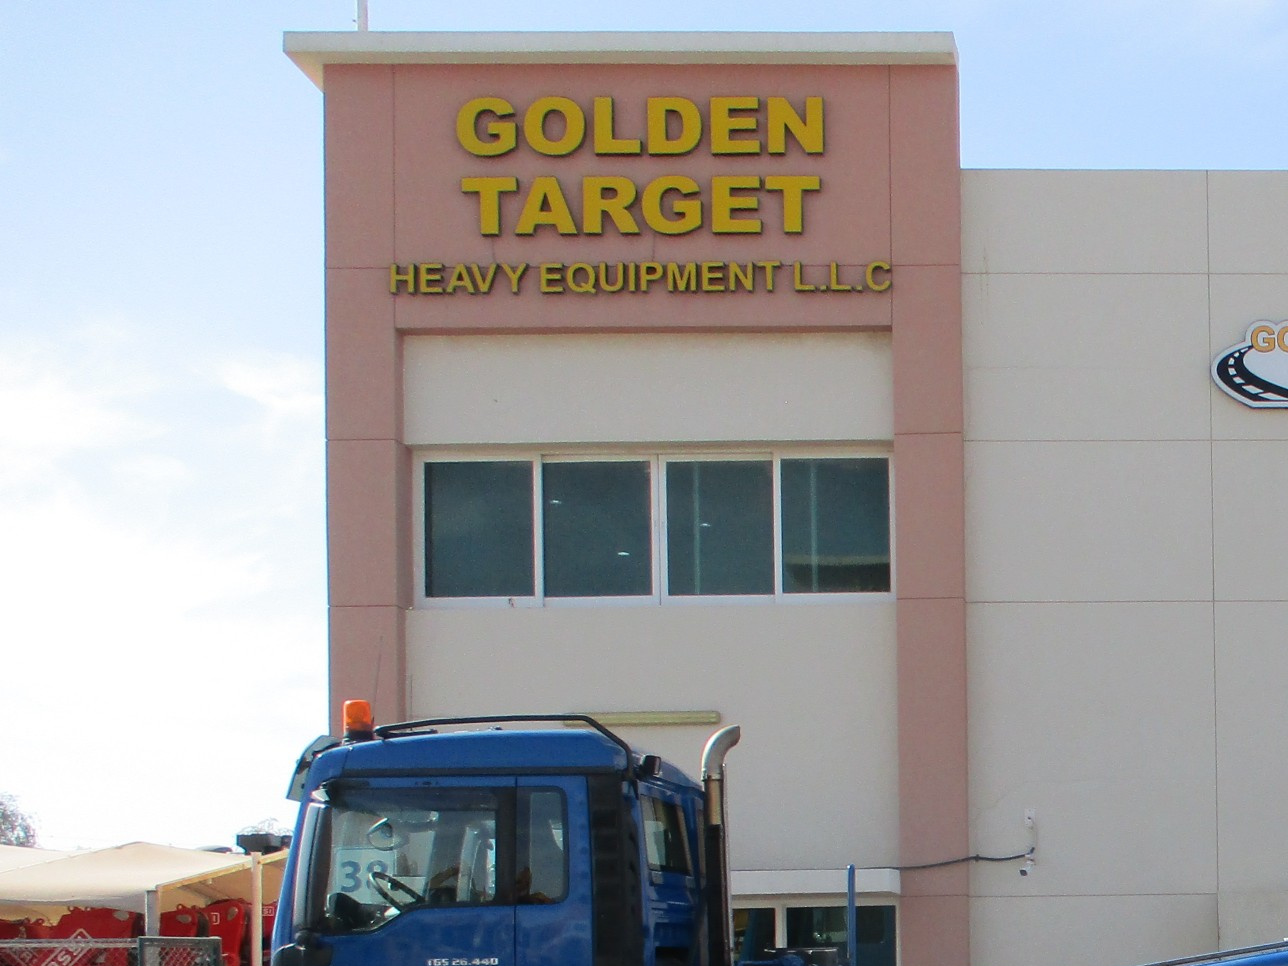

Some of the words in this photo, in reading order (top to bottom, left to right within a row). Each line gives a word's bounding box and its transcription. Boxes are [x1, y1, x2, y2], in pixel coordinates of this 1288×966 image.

[456, 96, 825, 157] GOLDEN
[460, 175, 821, 235] TARGET
[389, 262, 528, 294] HEAVY
[538, 260, 781, 294] EQUIPMENT
[793, 260, 893, 293] L.L.C
